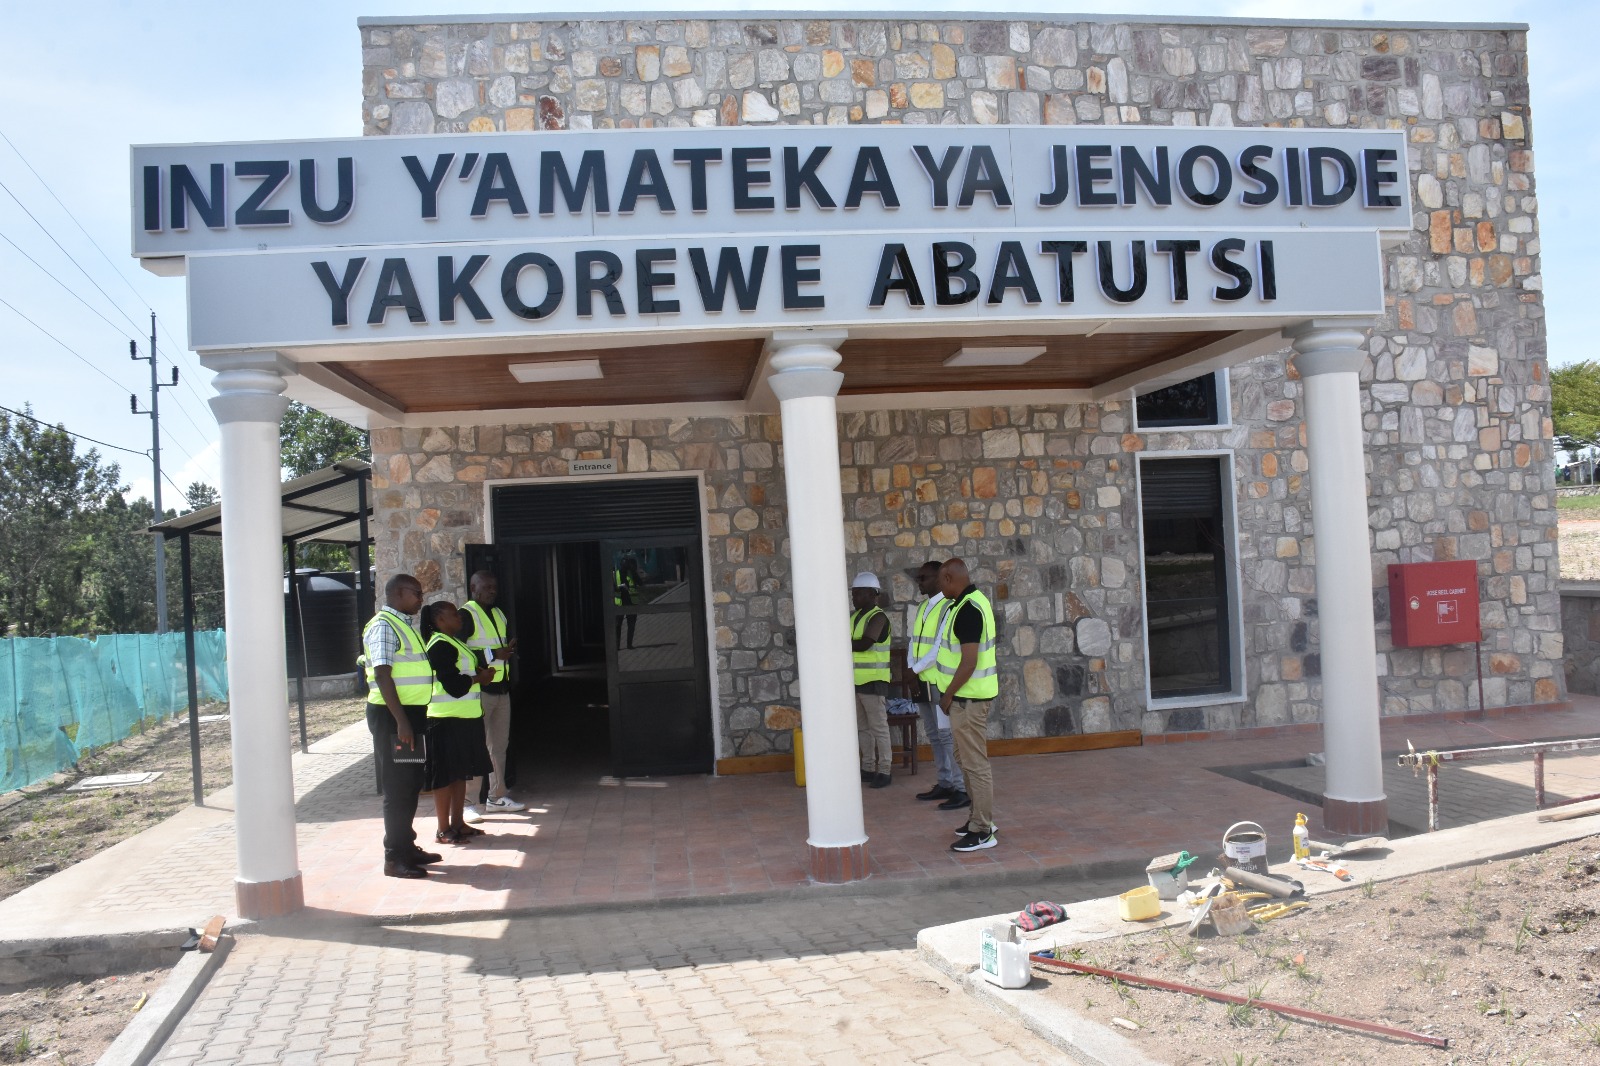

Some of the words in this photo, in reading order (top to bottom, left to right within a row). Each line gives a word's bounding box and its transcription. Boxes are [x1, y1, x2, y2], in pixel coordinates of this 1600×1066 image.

[143, 156, 355, 232] INZU
[910, 145, 1013, 209] YA
[1037, 144, 1402, 209] JENOSIDE
[310, 244, 826, 327] YAKOREWE
[867, 237, 1278, 309] ABATUTSI
[573, 463, 612, 471] Entrance
